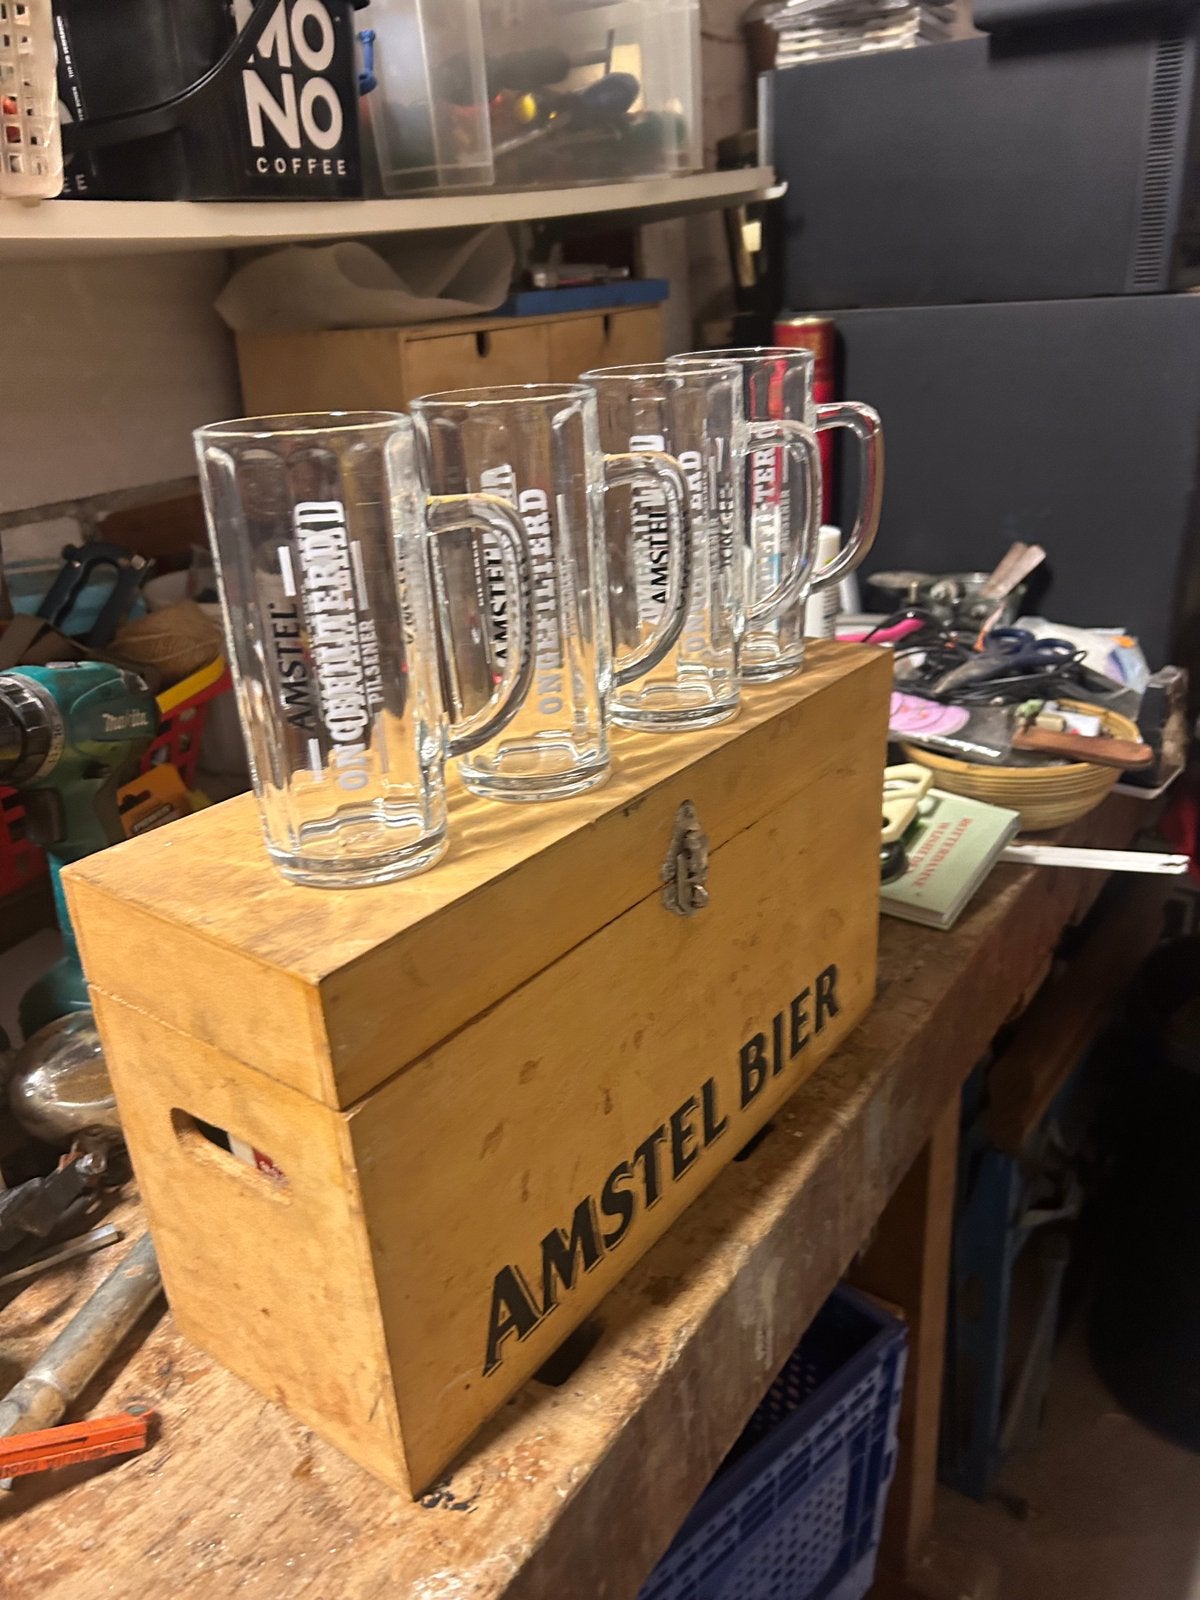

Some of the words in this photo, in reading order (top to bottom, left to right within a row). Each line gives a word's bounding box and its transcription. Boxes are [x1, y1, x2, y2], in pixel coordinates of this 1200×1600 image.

[242, 69, 343, 149] NO
[256, 157, 347, 175] COFFEE
[272, 602, 315, 731] AMSTEL
[361, 618, 385, 704] PILSENER
[482, 1077, 728, 1377] AMSTEL
[738, 963, 840, 1111] BIER
